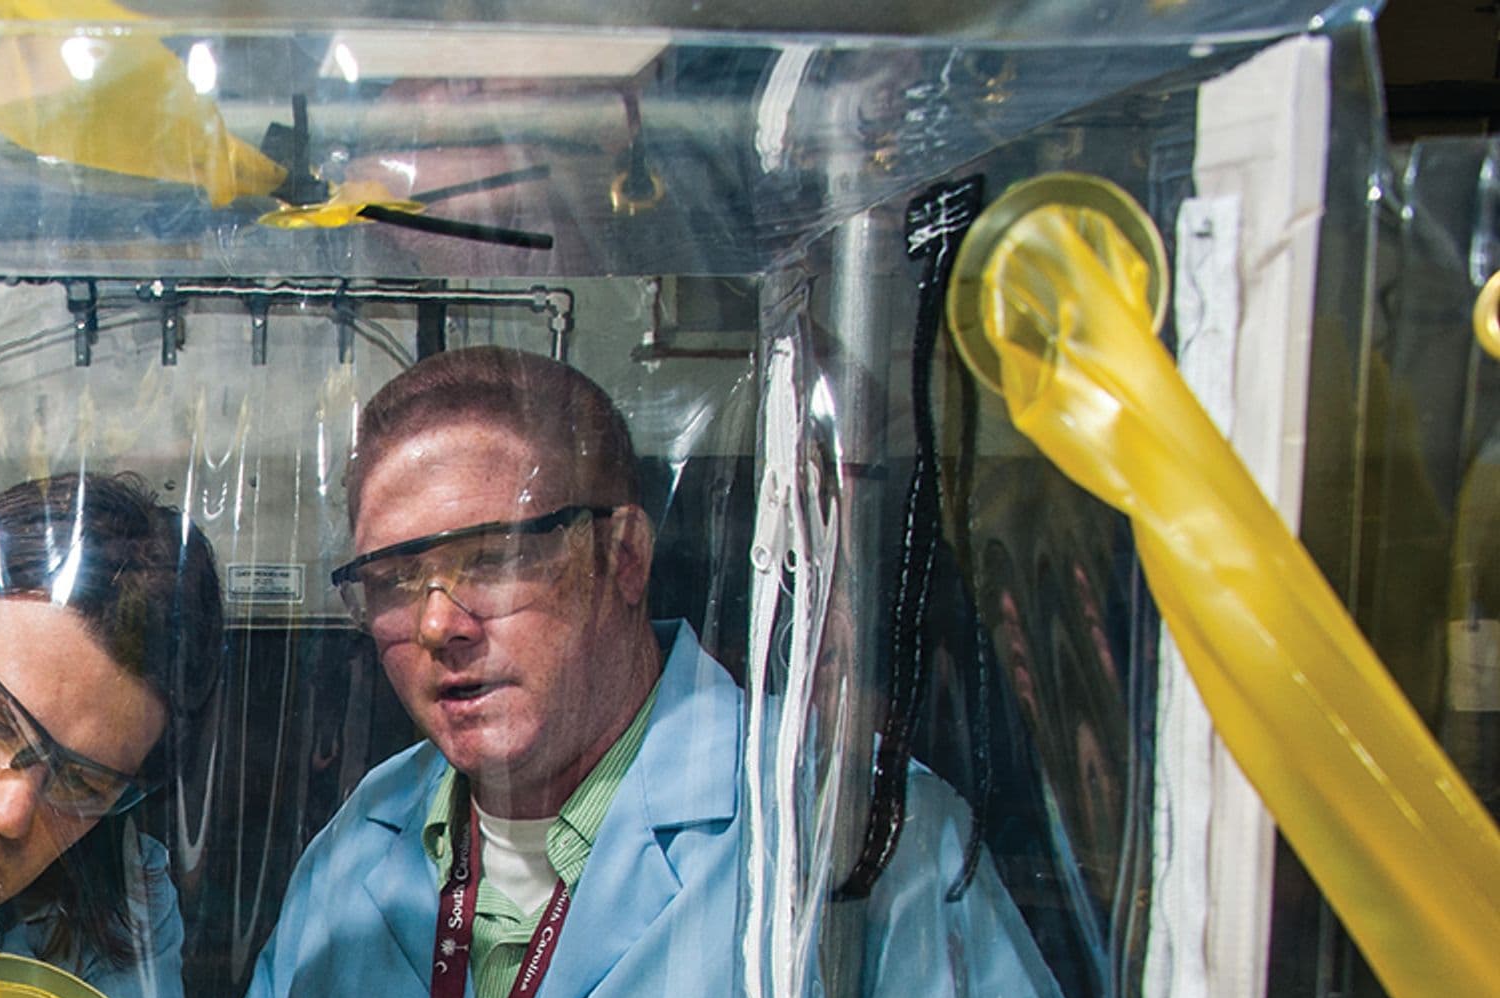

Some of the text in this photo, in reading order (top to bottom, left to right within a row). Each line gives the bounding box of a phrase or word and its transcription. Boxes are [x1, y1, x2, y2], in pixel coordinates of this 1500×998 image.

[447, 883, 466, 930] South
[520, 888, 569, 992] outh Carolina
